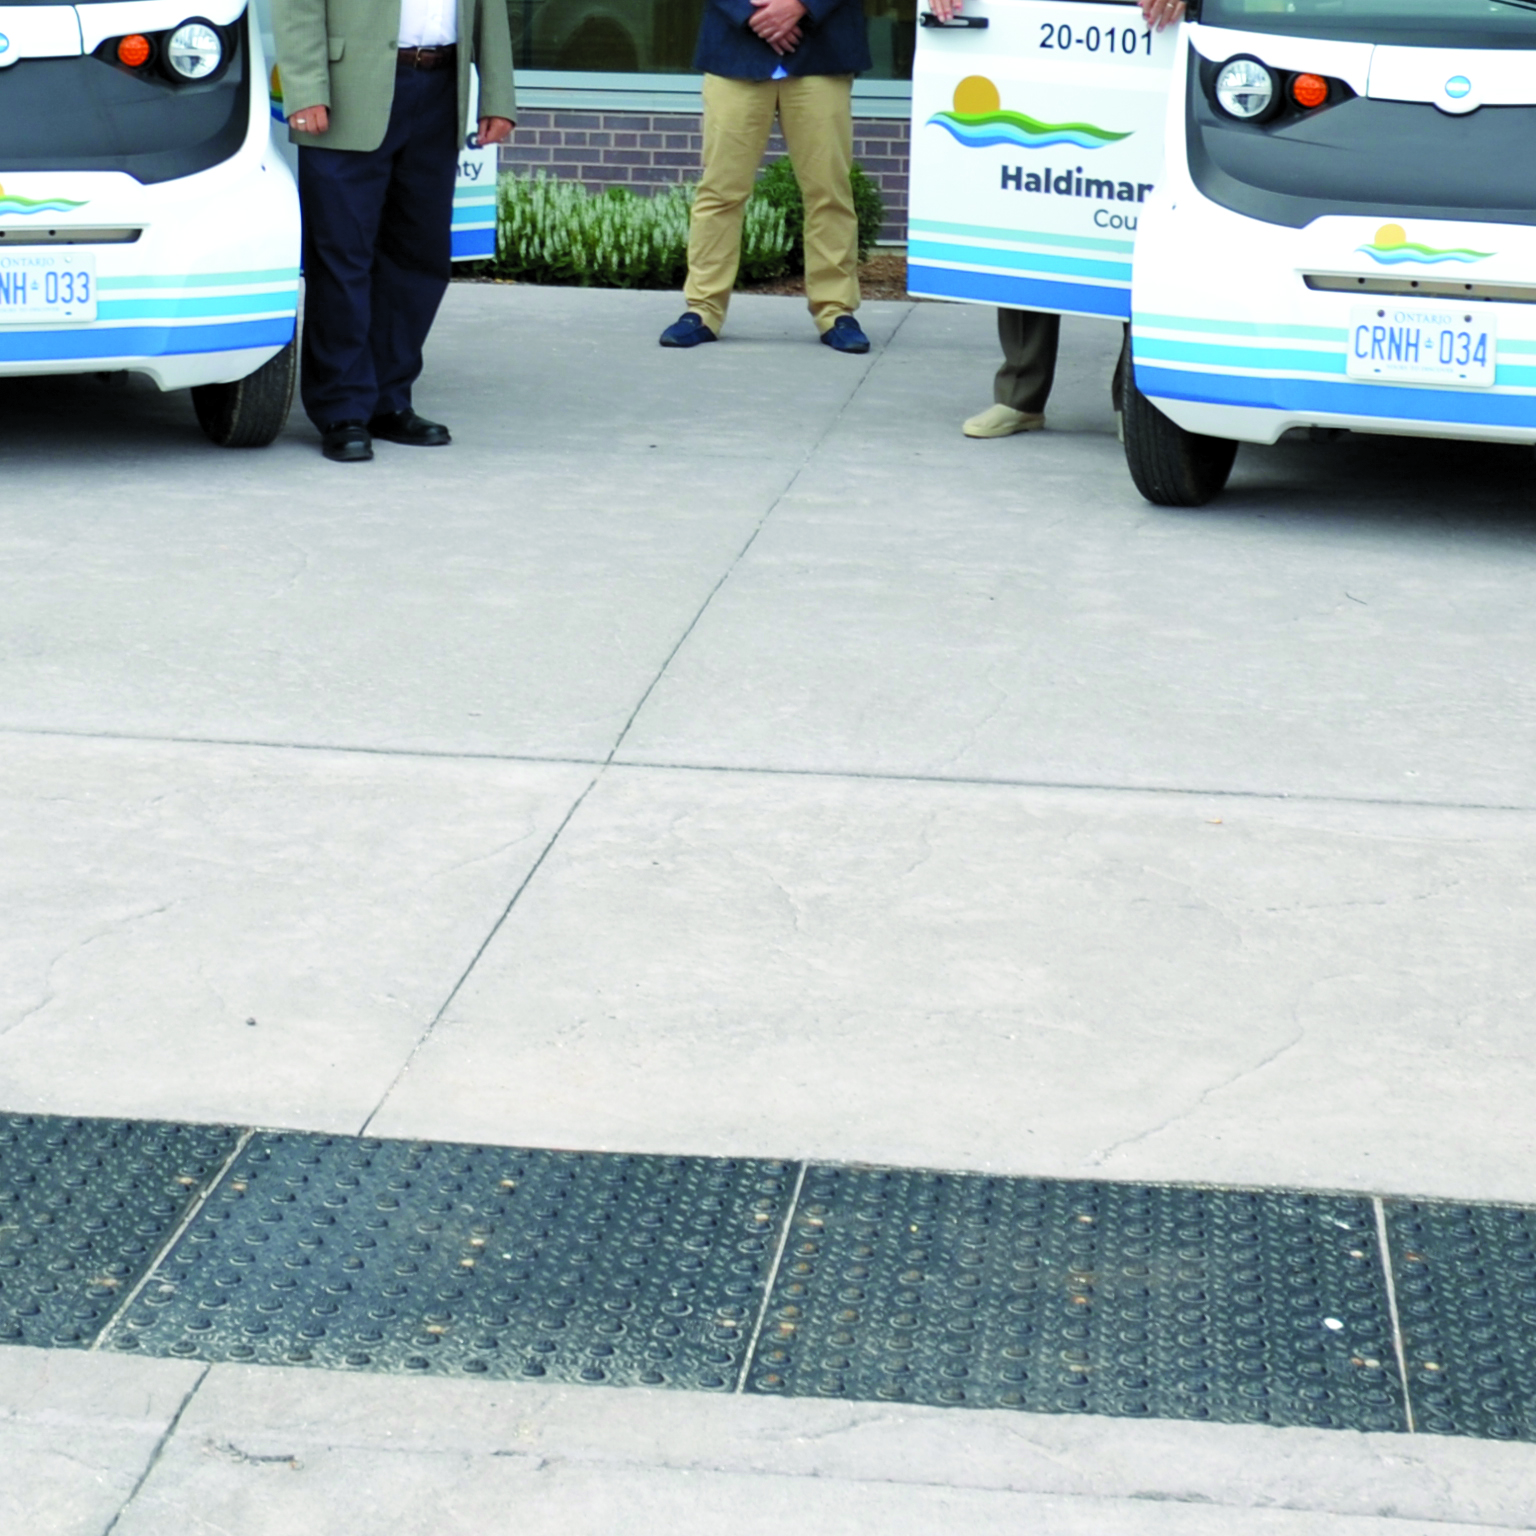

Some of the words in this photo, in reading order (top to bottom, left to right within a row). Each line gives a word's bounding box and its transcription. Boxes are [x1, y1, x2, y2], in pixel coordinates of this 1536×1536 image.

[1039, 23, 1153, 55] 20-0101
[1001, 164, 1155, 203] Haldiman
[1093, 208, 1138, 231] Cou
[45, 271, 90, 304] 033
[1355, 325, 1420, 363] CRNH
[1439, 330, 1487, 367] 034
